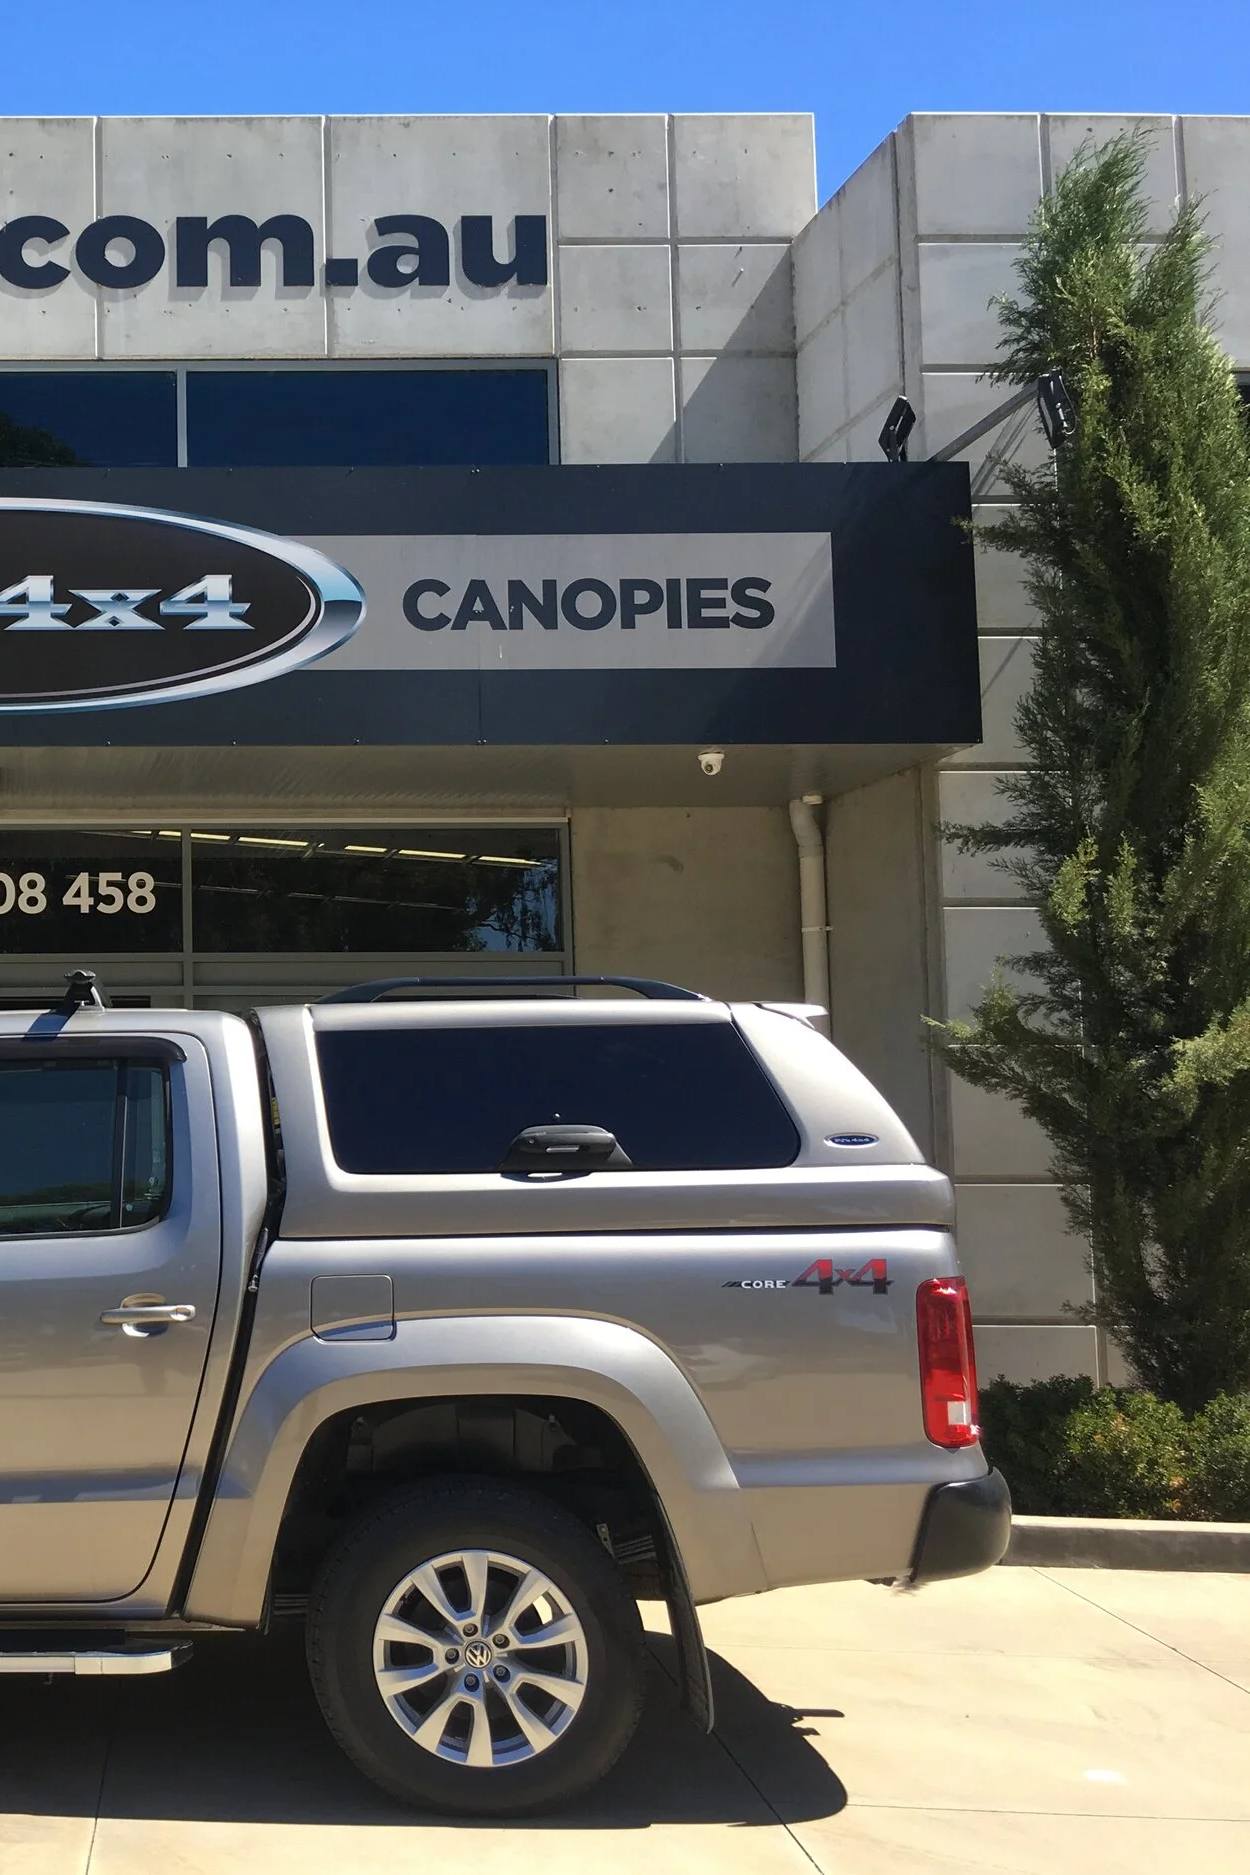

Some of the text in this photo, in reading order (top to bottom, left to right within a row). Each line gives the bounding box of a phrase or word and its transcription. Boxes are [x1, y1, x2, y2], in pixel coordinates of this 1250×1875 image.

[403, 577, 775, 632] CANOPIES
[62, 872, 156, 914] 458
[741, 1258, 894, 1295] CORE 4x4
